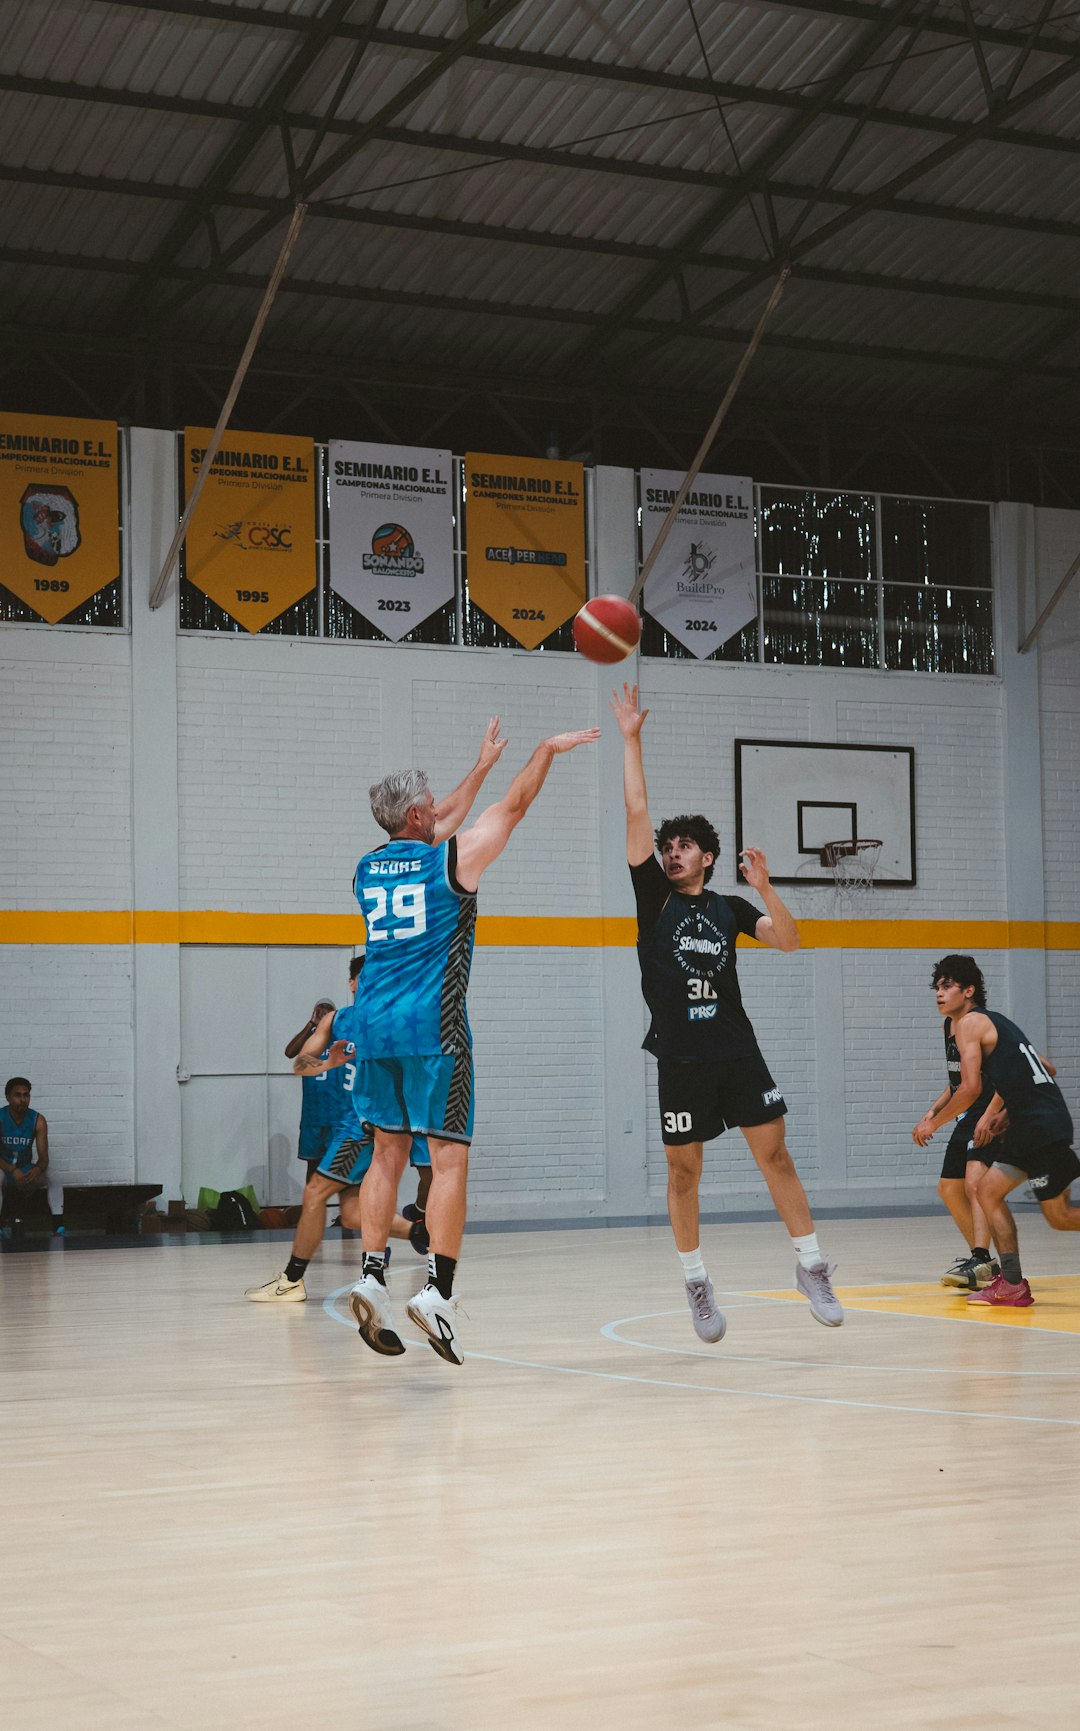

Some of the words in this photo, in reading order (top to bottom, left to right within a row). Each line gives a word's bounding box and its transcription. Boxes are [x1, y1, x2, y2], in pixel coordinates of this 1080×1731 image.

[0, 434, 79, 456] EMINARIO
[84, 440, 112, 458] E.L.
[0, 453, 48, 464] MPEONES
[50, 456, 110, 468] NACIONALES
[282, 456, 309, 473] E.L.
[15, 464, 49, 475] Primera
[193, 466, 248, 478] CMPEONES
[250, 472, 308, 483] NACIONALES
[334, 460, 418, 482] SEMINARIO
[422, 470, 448, 484] E.L.
[218, 479, 250, 488] Primera
[336, 479, 391, 490] CAMPEONAS
[392, 484, 446, 495] NACIONALES
[471, 473, 551, 494] SEMINARIO
[554, 480, 579, 496] E.L.
[360, 491, 391, 501] Primera
[473, 490, 524, 500] CAMPEONES
[526, 495, 578, 506] NACIONALES
[725, 495, 749, 510] E.L.
[648, 505, 697, 516] CAMPNAS
[699, 509, 748, 520] NACIONALES
[674, 518, 698, 526] rimera
[248, 527, 293, 548] CRSC
[487, 548, 508, 560] ACE
[517, 550, 536, 562] PER
[34, 579, 70, 592] 1989
[676, 582, 725, 595] BuildPro
[236, 590, 269, 603] 1995
[377, 600, 411, 612] 2023
[512, 608, 545, 621] 2024
[685, 619, 718, 631] 2024
[363, 883, 426, 942] 29
[716, 950, 728, 972] Gold
[687, 978, 718, 1000] 30
[664, 1112, 692, 1133] 30
